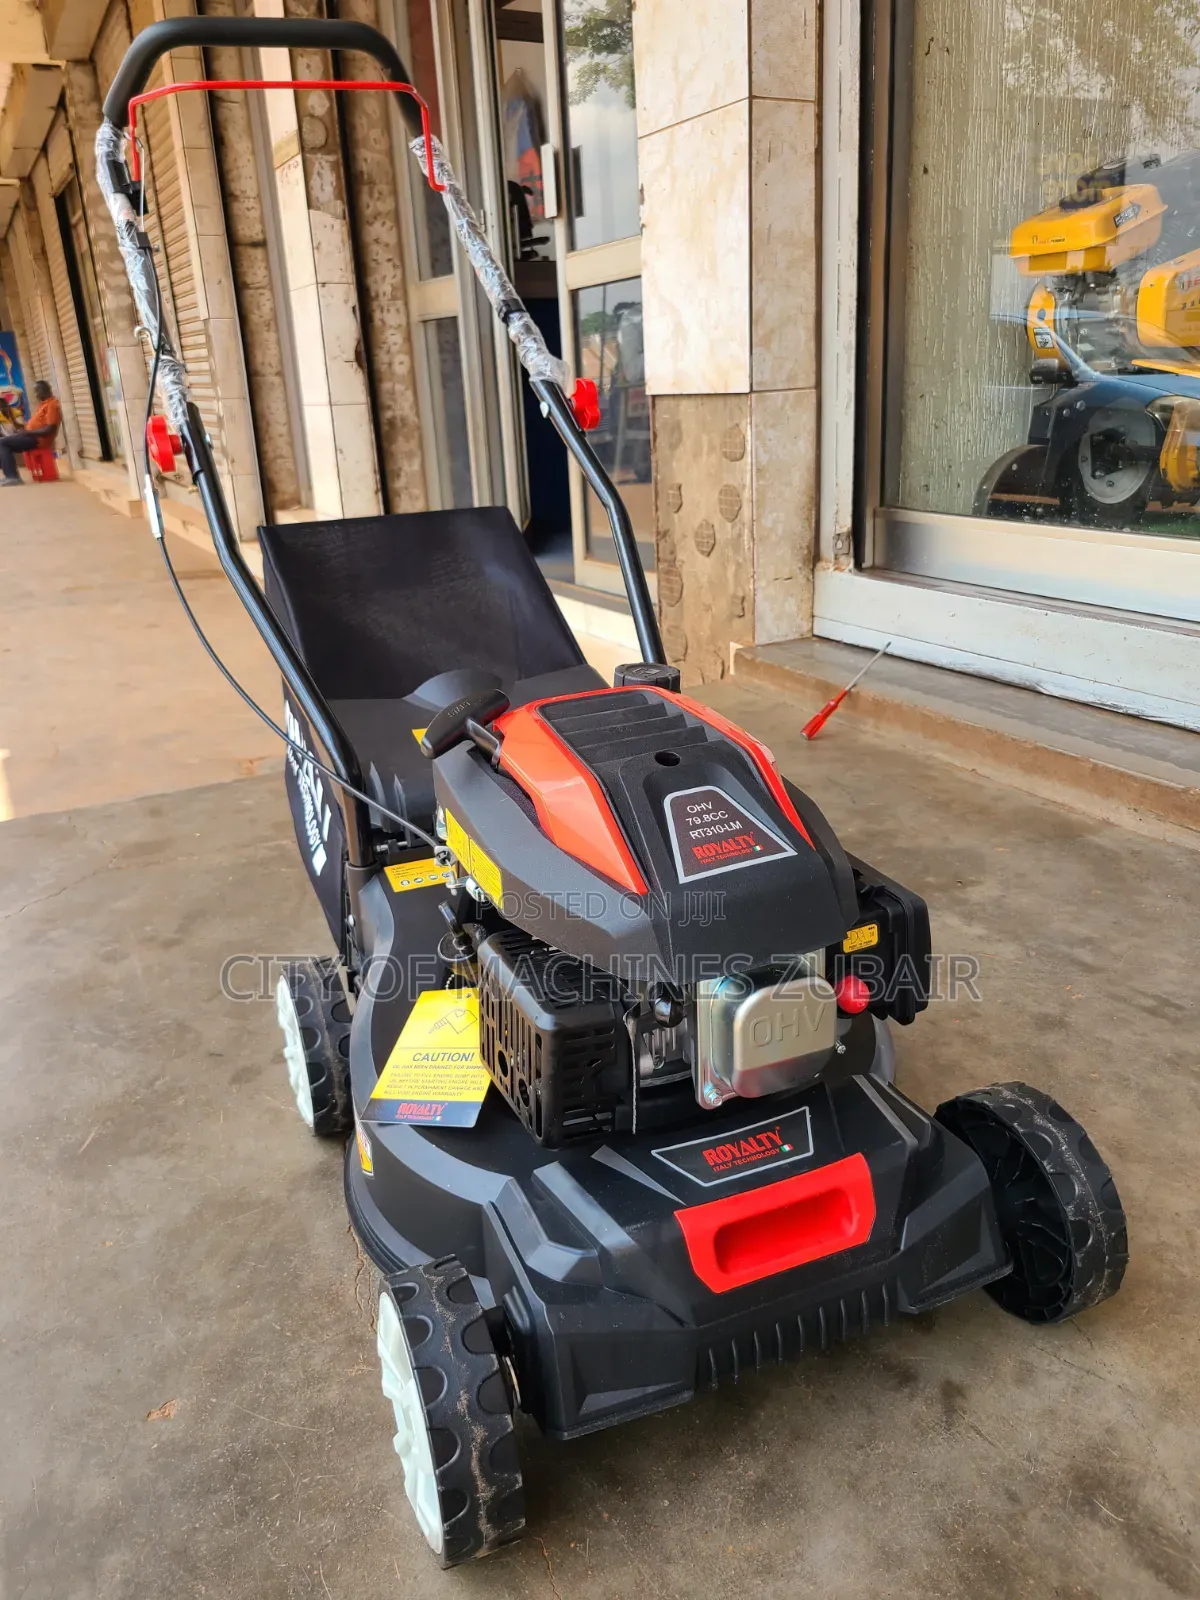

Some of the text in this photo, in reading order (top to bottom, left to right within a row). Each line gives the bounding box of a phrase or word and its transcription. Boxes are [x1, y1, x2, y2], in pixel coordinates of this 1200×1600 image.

[686, 801, 714, 814] OHV
[685, 811, 729, 826] 79.8CC
[689, 820, 743, 840] RT310-LM
[691, 833, 757, 860] ROYALTY
[699, 848, 754, 864] ITALY TECHNOLOGY
[751, 1003, 826, 1047] OHV
[412, 1052, 475, 1062] CAUTION!
[397, 1102, 446, 1115] ROYALTY
[702, 1128, 783, 1166] ROYALTY
[712, 1148, 781, 1173] ITALY TECHNOLOGY
